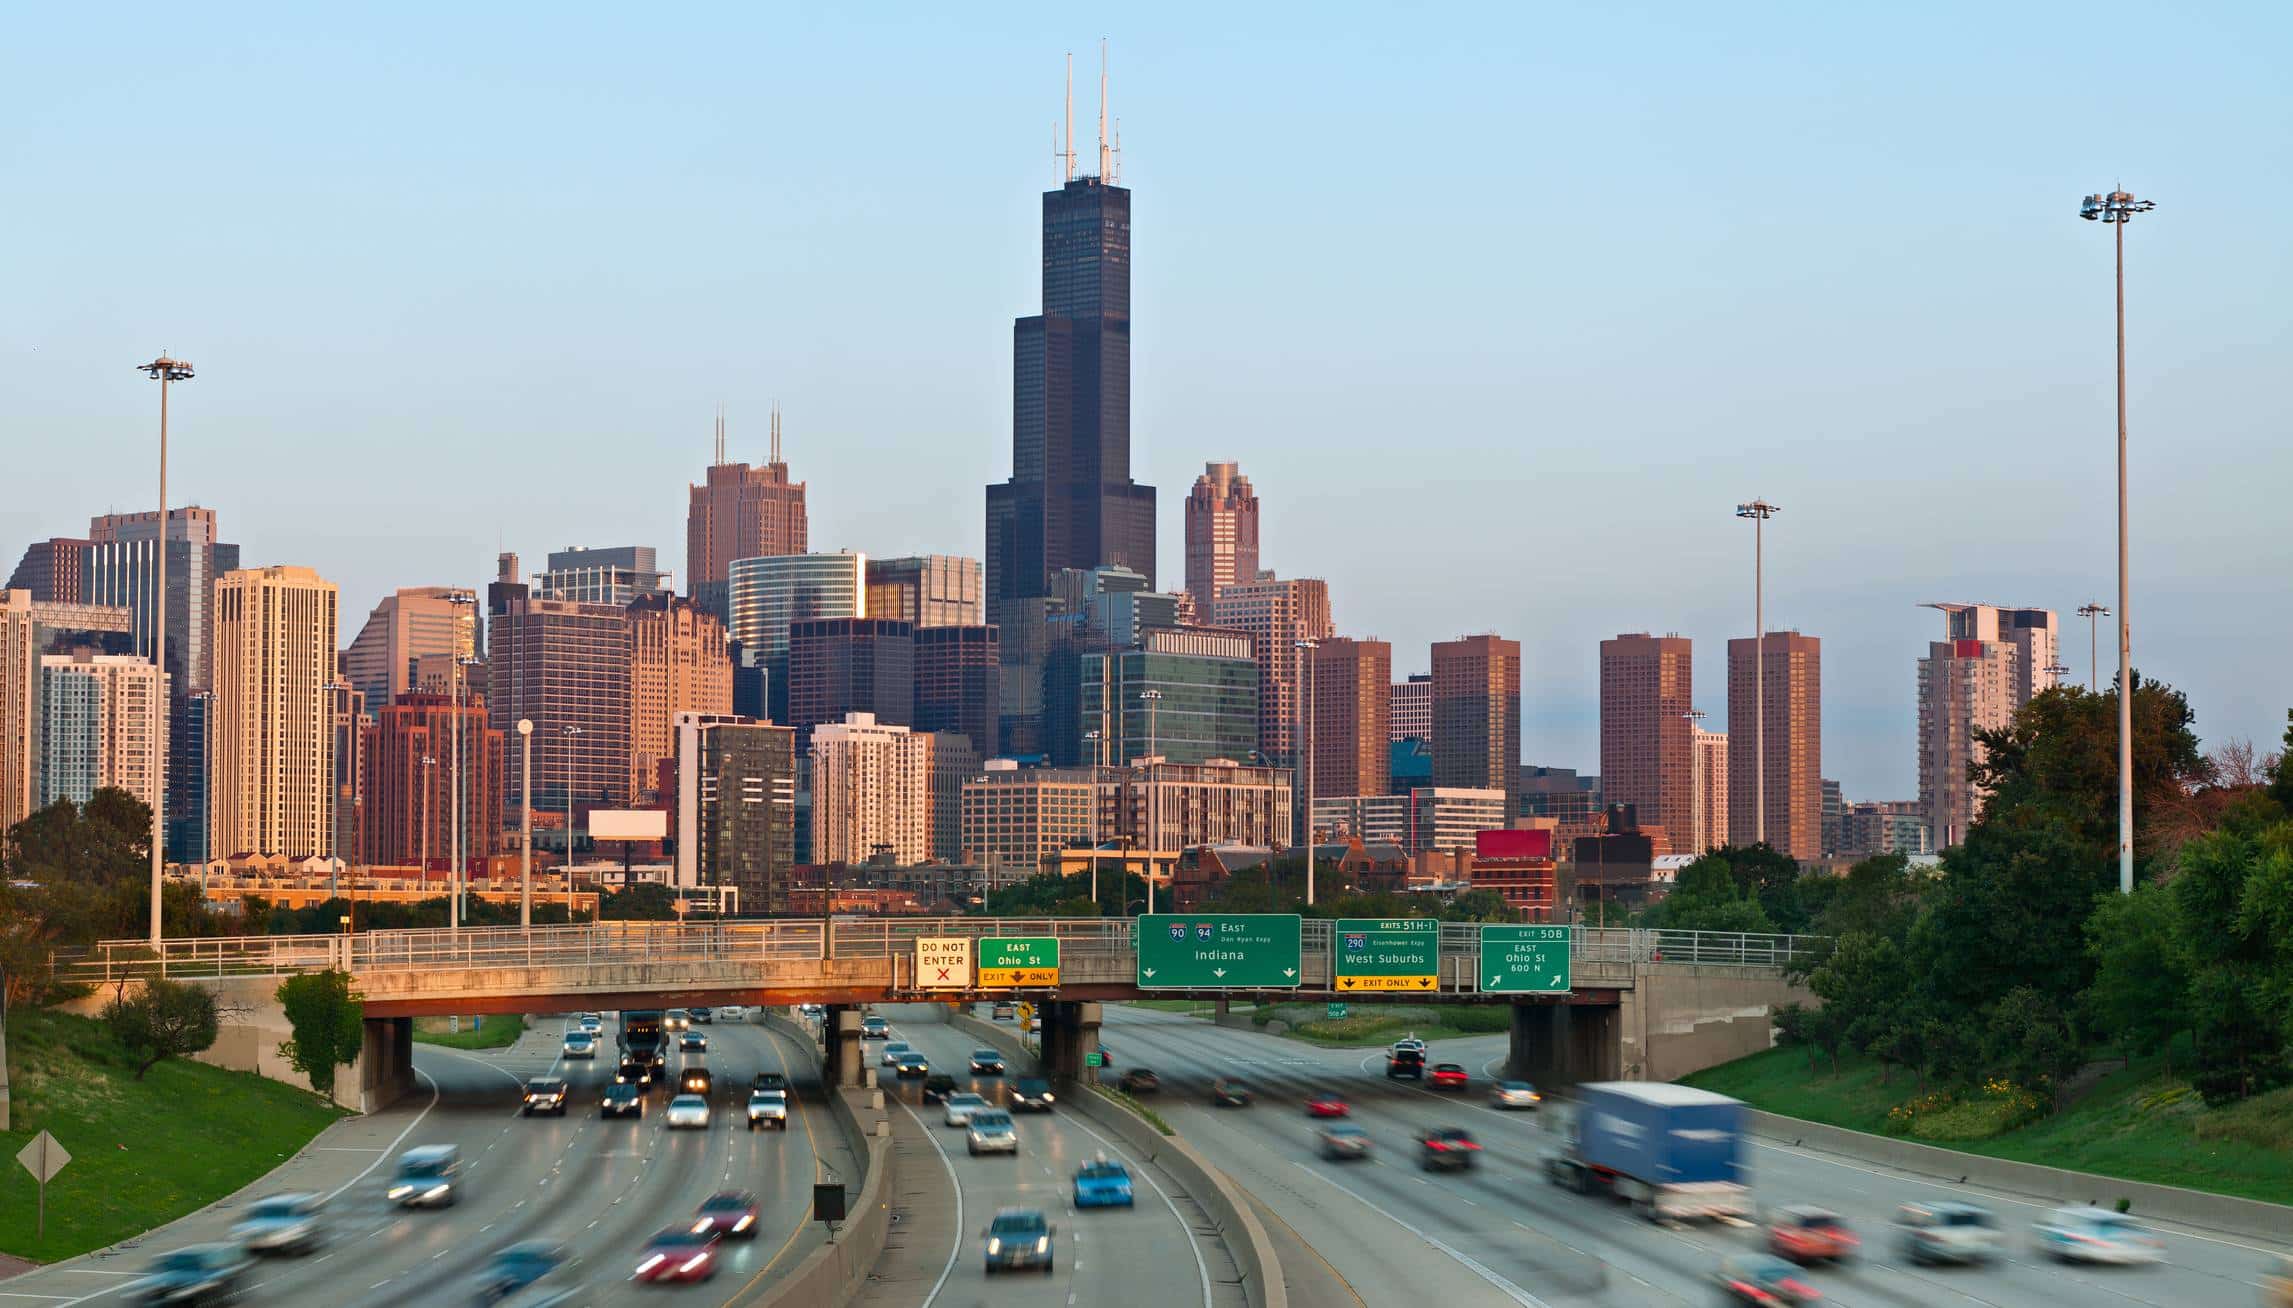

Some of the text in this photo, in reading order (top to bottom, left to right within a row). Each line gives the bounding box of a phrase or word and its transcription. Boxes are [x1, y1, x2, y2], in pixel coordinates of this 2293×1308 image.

[1171, 923, 1246, 938] 90 94 EAST
[1540, 929, 1563, 939] 50B
[922, 943, 965, 952] DO NOT
[1007, 943, 1030, 952] EAST
[1347, 938, 1364, 948] 290
[1514, 944, 1537, 952] EAST
[1195, 950, 1245, 961] Indiana
[1345, 954, 1424, 964] West Suburbs
[1505, 954, 1545, 962] Ohio St
[924, 956, 964, 965] ENTER
[997, 956, 1041, 965] Ohio St
[1511, 964, 1541, 972] 600 N
[983, 973, 1054, 981] EXIT ONLY
[1363, 979, 1410, 987] EXIT ONLY
